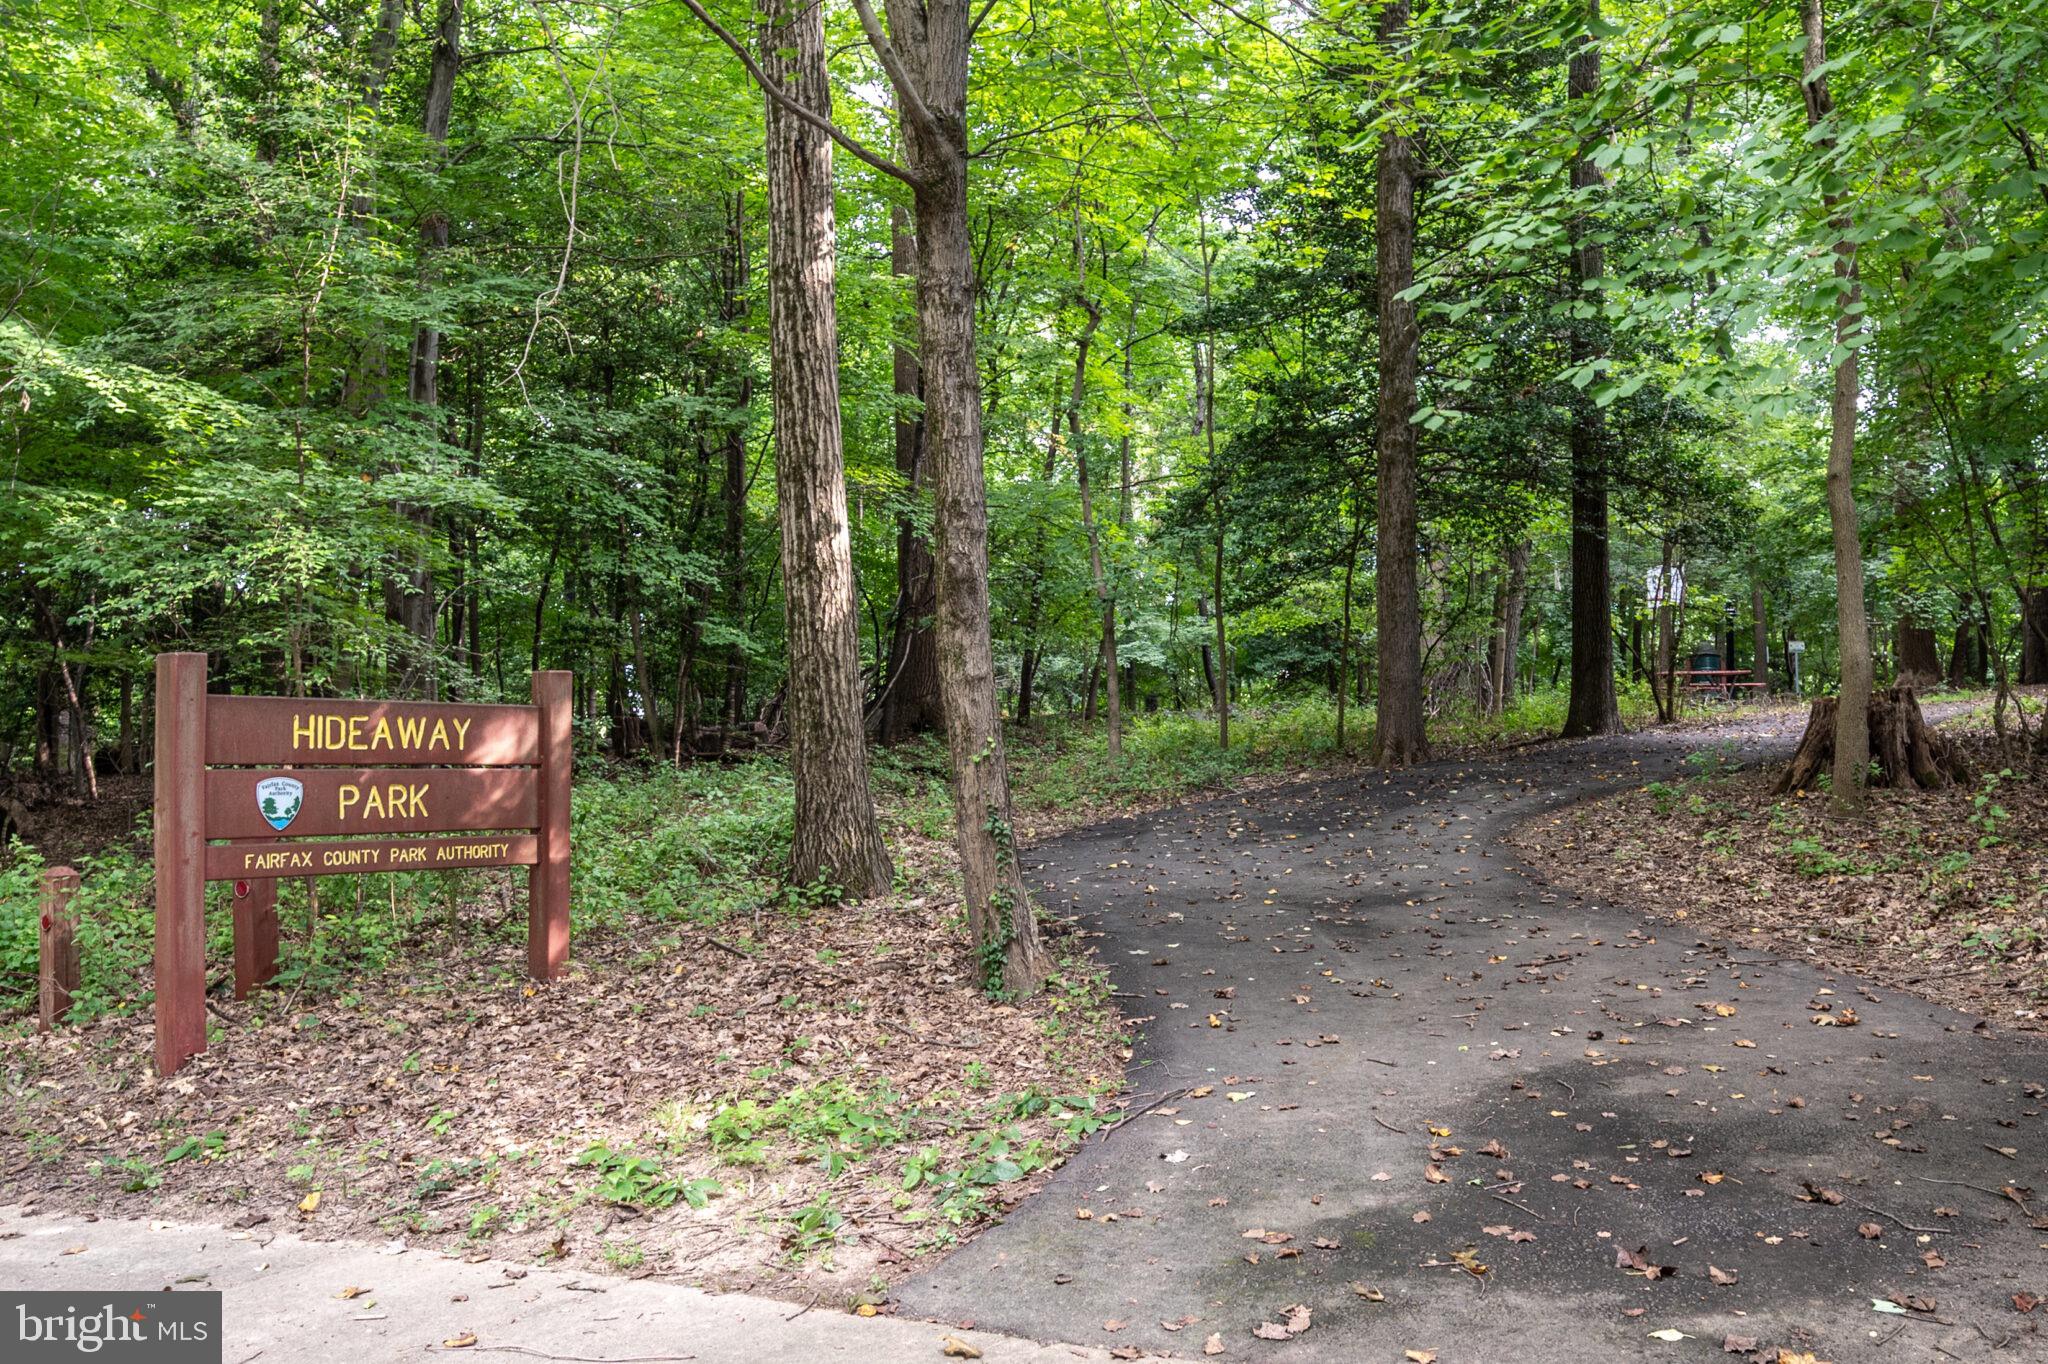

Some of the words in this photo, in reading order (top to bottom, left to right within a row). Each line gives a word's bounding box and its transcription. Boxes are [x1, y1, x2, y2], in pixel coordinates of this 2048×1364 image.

[292, 714, 472, 751] HIDEAWAY
[281, 781, 300, 790] County
[338, 783, 430, 820] PARK
[244, 851, 313, 870] FAIRFAX
[323, 848, 380, 866] COUNTY
[390, 846, 427, 863] PARK
[436, 843, 509, 861] AUTHORITY
